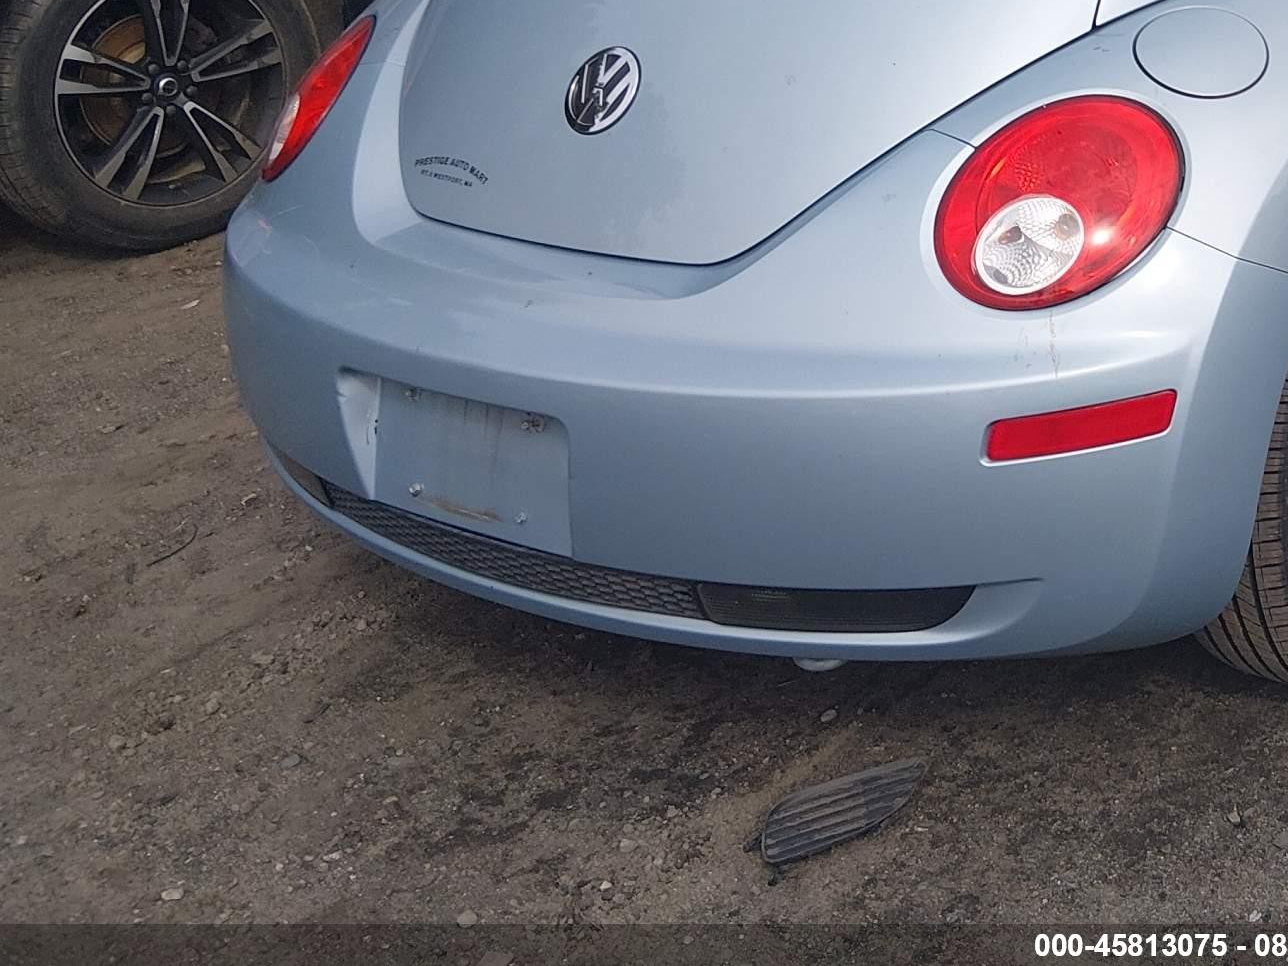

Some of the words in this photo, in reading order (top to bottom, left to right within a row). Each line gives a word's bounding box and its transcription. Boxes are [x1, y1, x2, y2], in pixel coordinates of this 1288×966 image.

[414, 156, 450, 167] PRESTIGE
[450, 158, 470, 171] AUTO
[469, 165, 489, 185] MART
